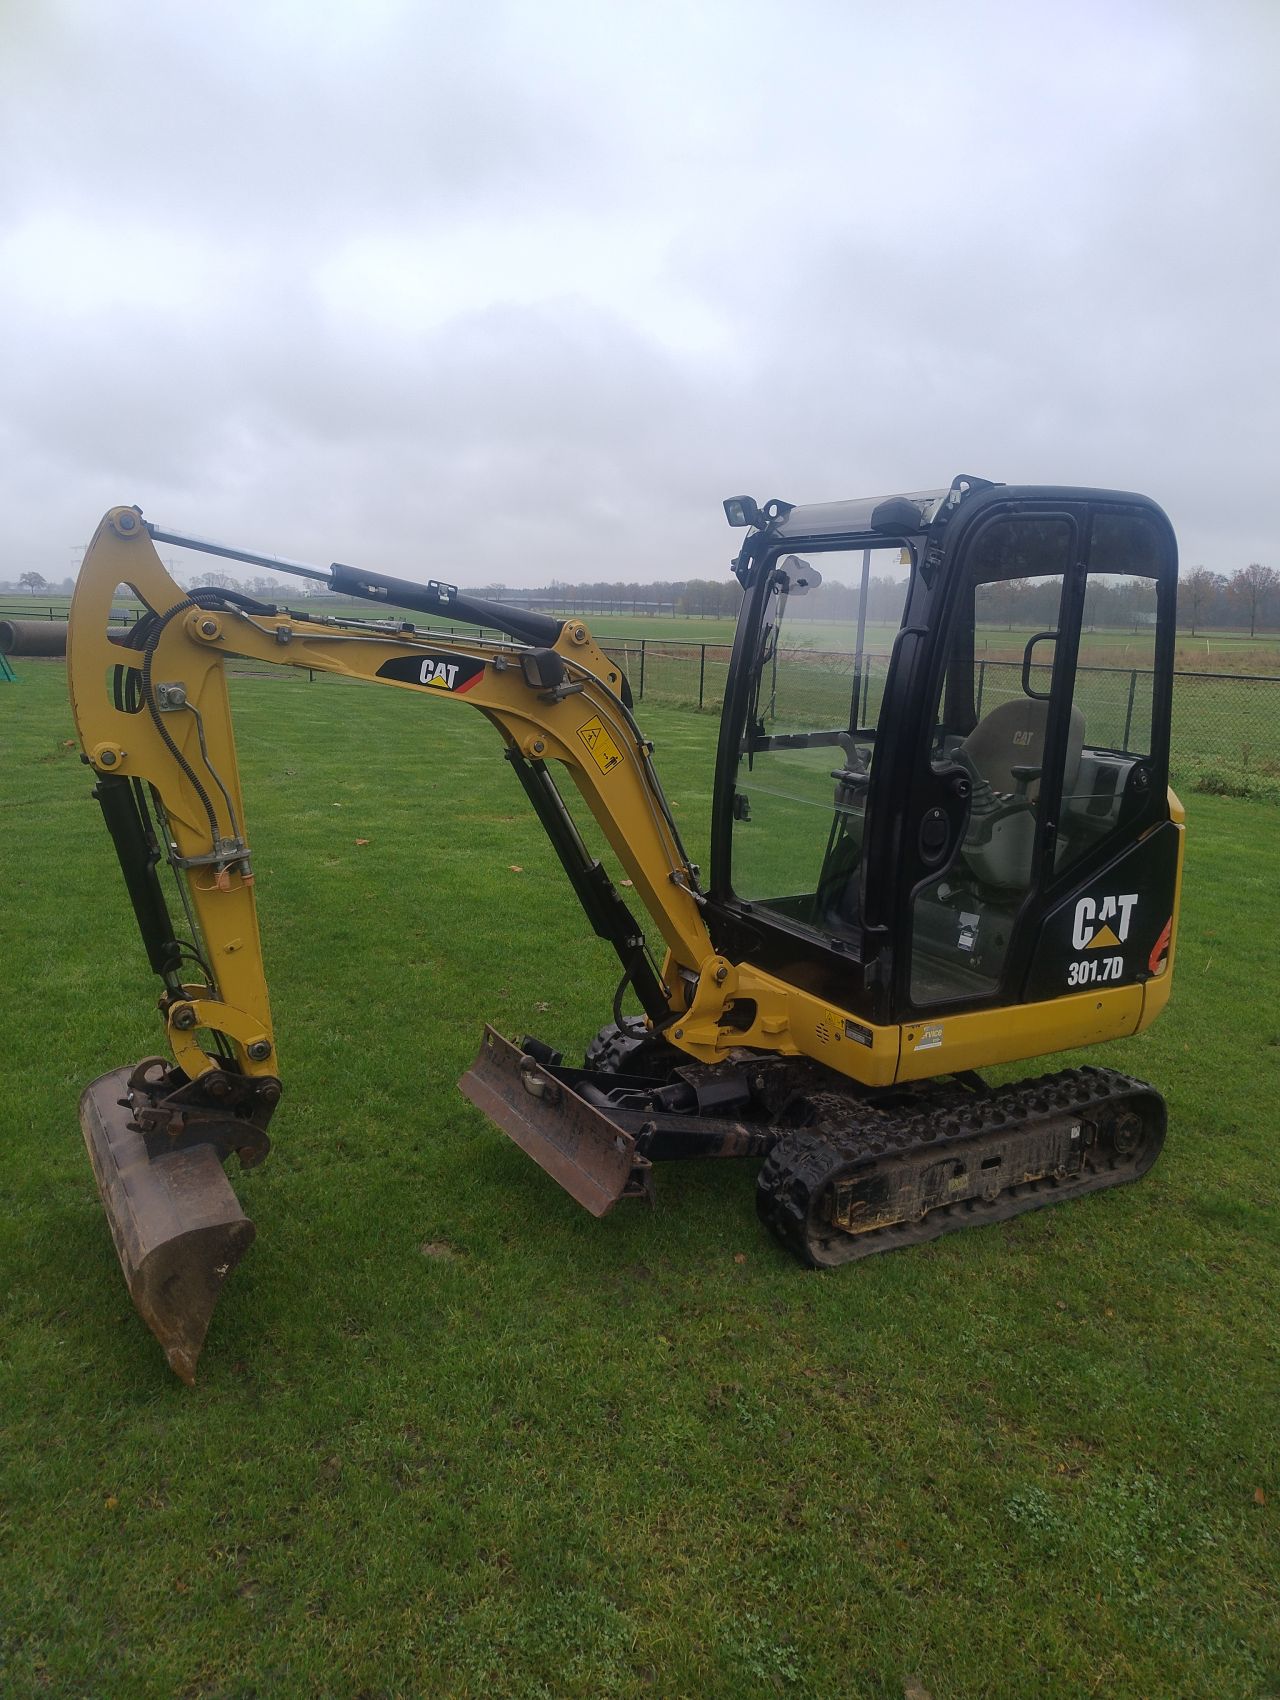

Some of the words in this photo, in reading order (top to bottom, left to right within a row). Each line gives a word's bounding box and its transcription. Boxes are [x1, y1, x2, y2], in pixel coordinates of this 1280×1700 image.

[420, 659, 459, 689] CAT
[1013, 730, 1034, 746] CAT
[1072, 894, 1138, 950] CAT
[1067, 957, 1123, 986] 301.7D
